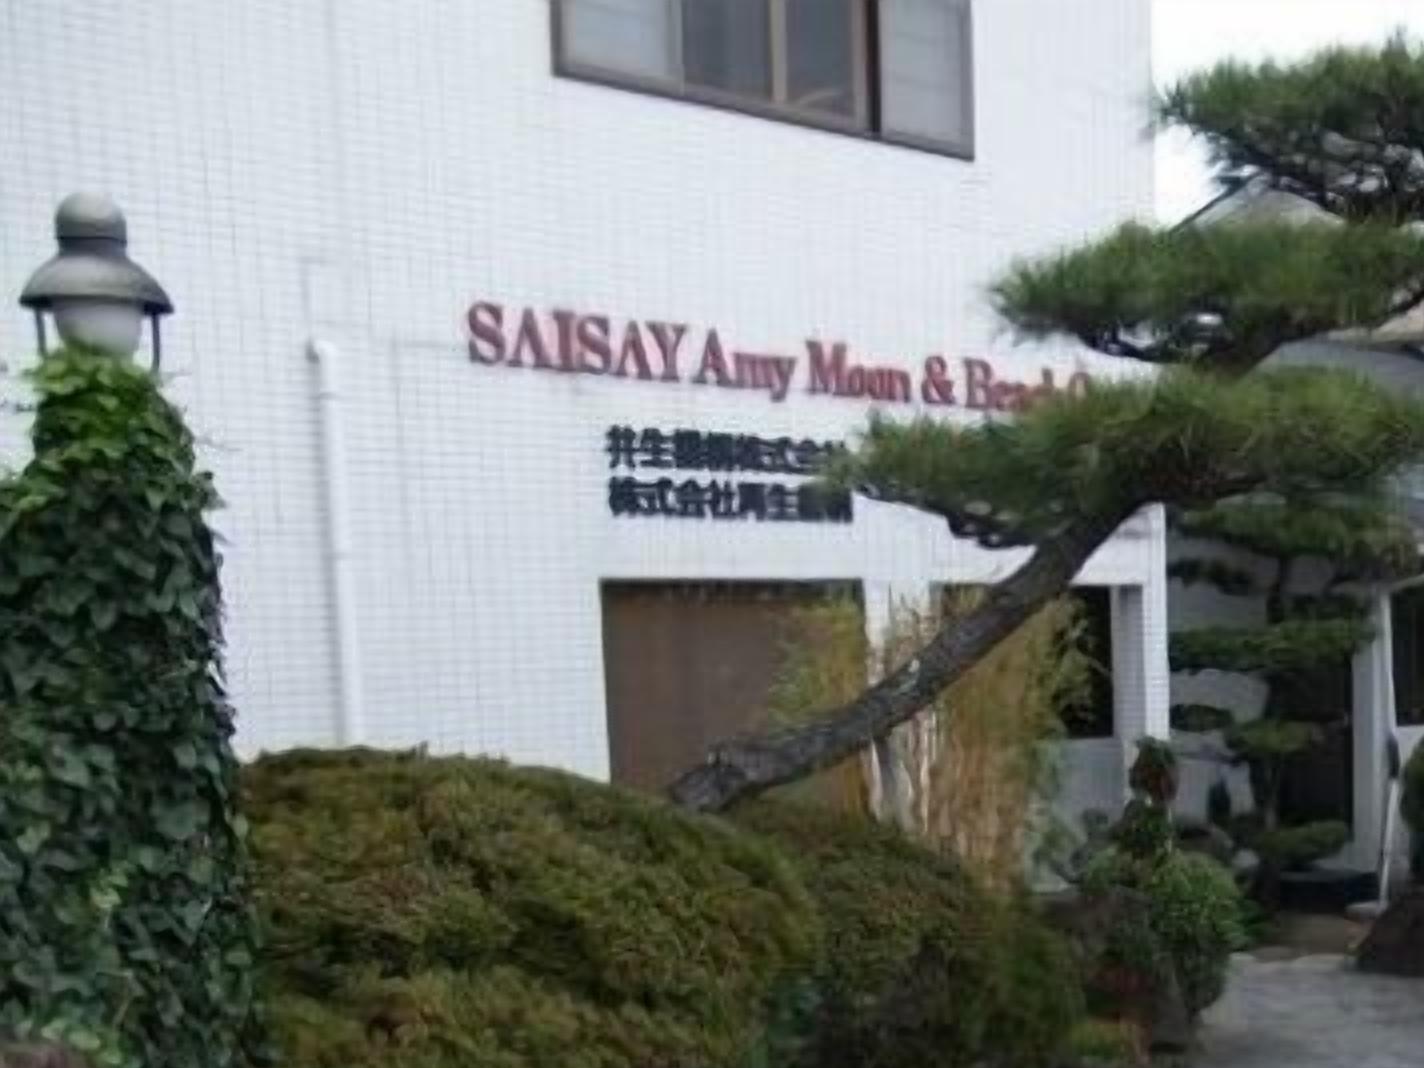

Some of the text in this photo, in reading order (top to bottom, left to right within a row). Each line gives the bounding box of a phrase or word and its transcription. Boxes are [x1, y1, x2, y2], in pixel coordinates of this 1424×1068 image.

[467, 300, 688, 378] SAISAY
[692, 326, 797, 402] Amy
[805, 339, 912, 404] Moon
[920, 355, 957, 405] &
